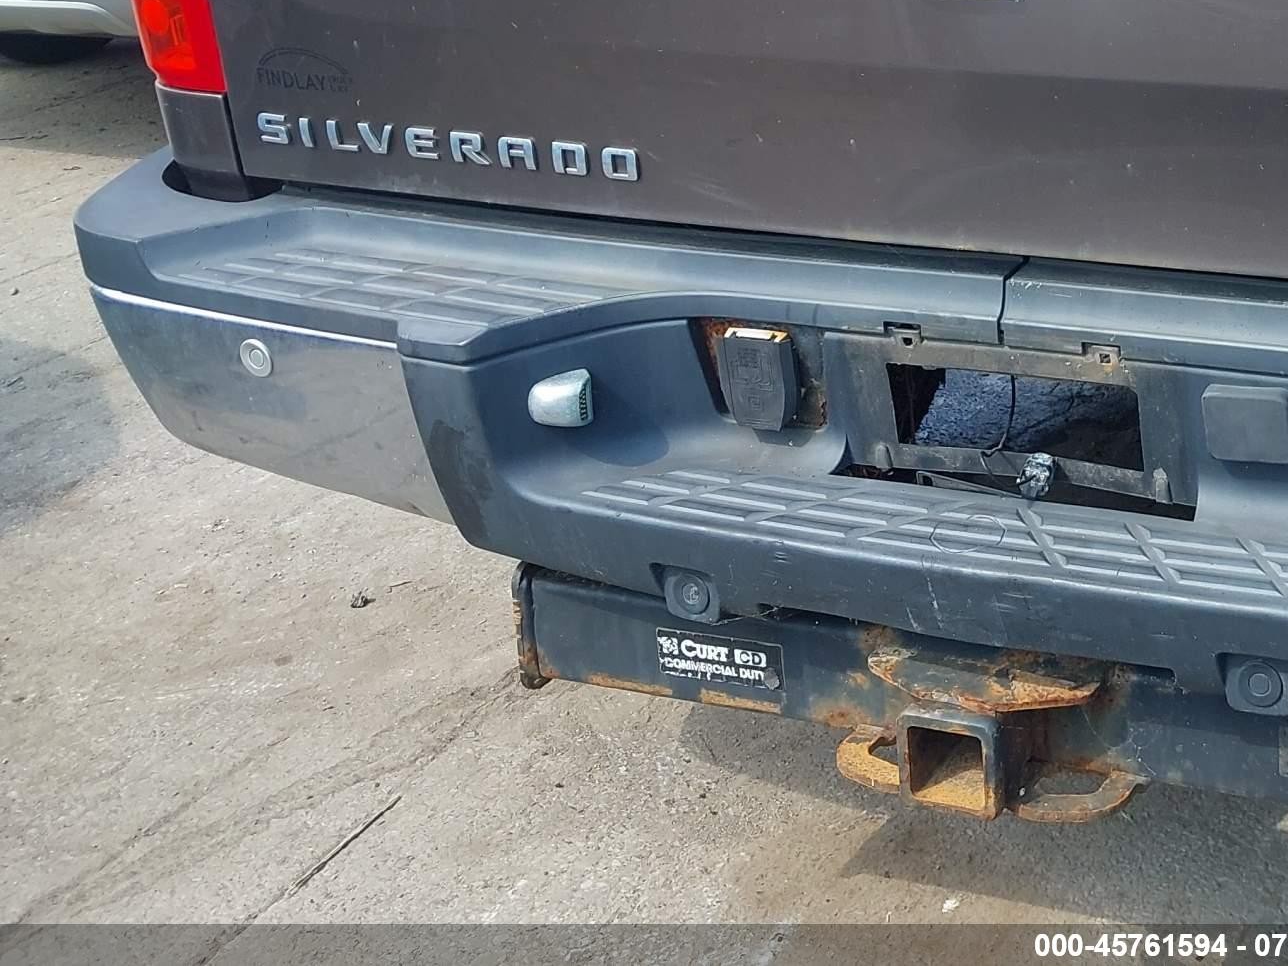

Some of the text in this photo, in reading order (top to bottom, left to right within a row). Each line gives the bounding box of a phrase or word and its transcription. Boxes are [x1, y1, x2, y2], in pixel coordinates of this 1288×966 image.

[256, 68, 325, 91] FINDLAY
[257, 112, 642, 181] SILVERADO
[664, 657, 738, 677] COMMERCIAL
[737, 650, 765, 665] CD
